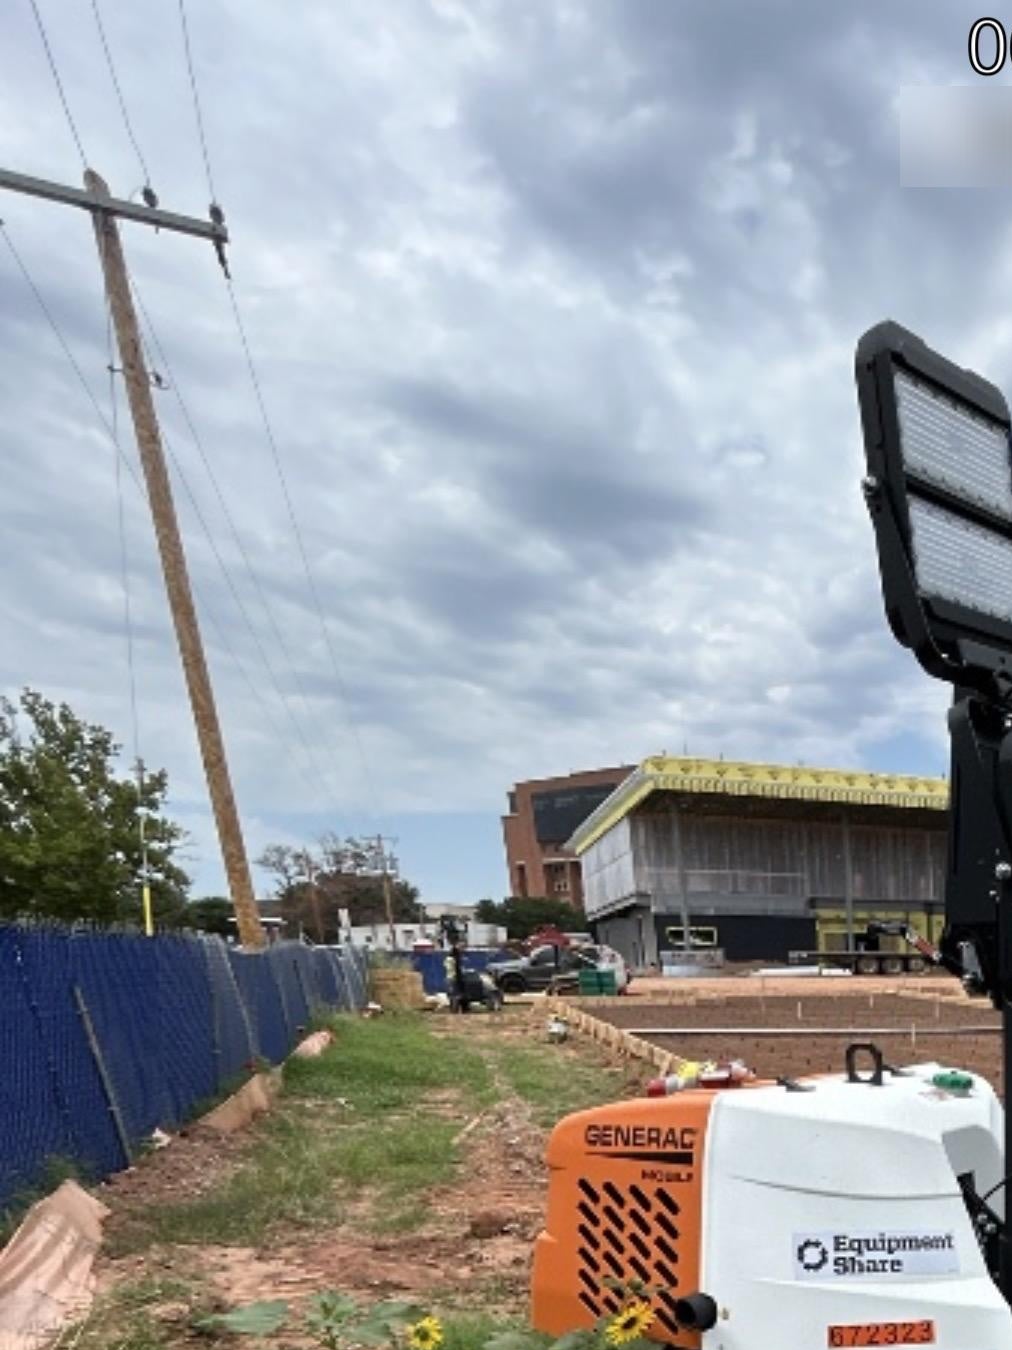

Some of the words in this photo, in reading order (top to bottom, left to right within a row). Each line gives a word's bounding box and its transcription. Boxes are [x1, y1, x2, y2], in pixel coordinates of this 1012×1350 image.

[584, 1124, 697, 1149] GENERAC
[833, 1233, 954, 1254] Equipment
[833, 1256, 903, 1275] Share
[829, 1320, 934, 1348] 672323
